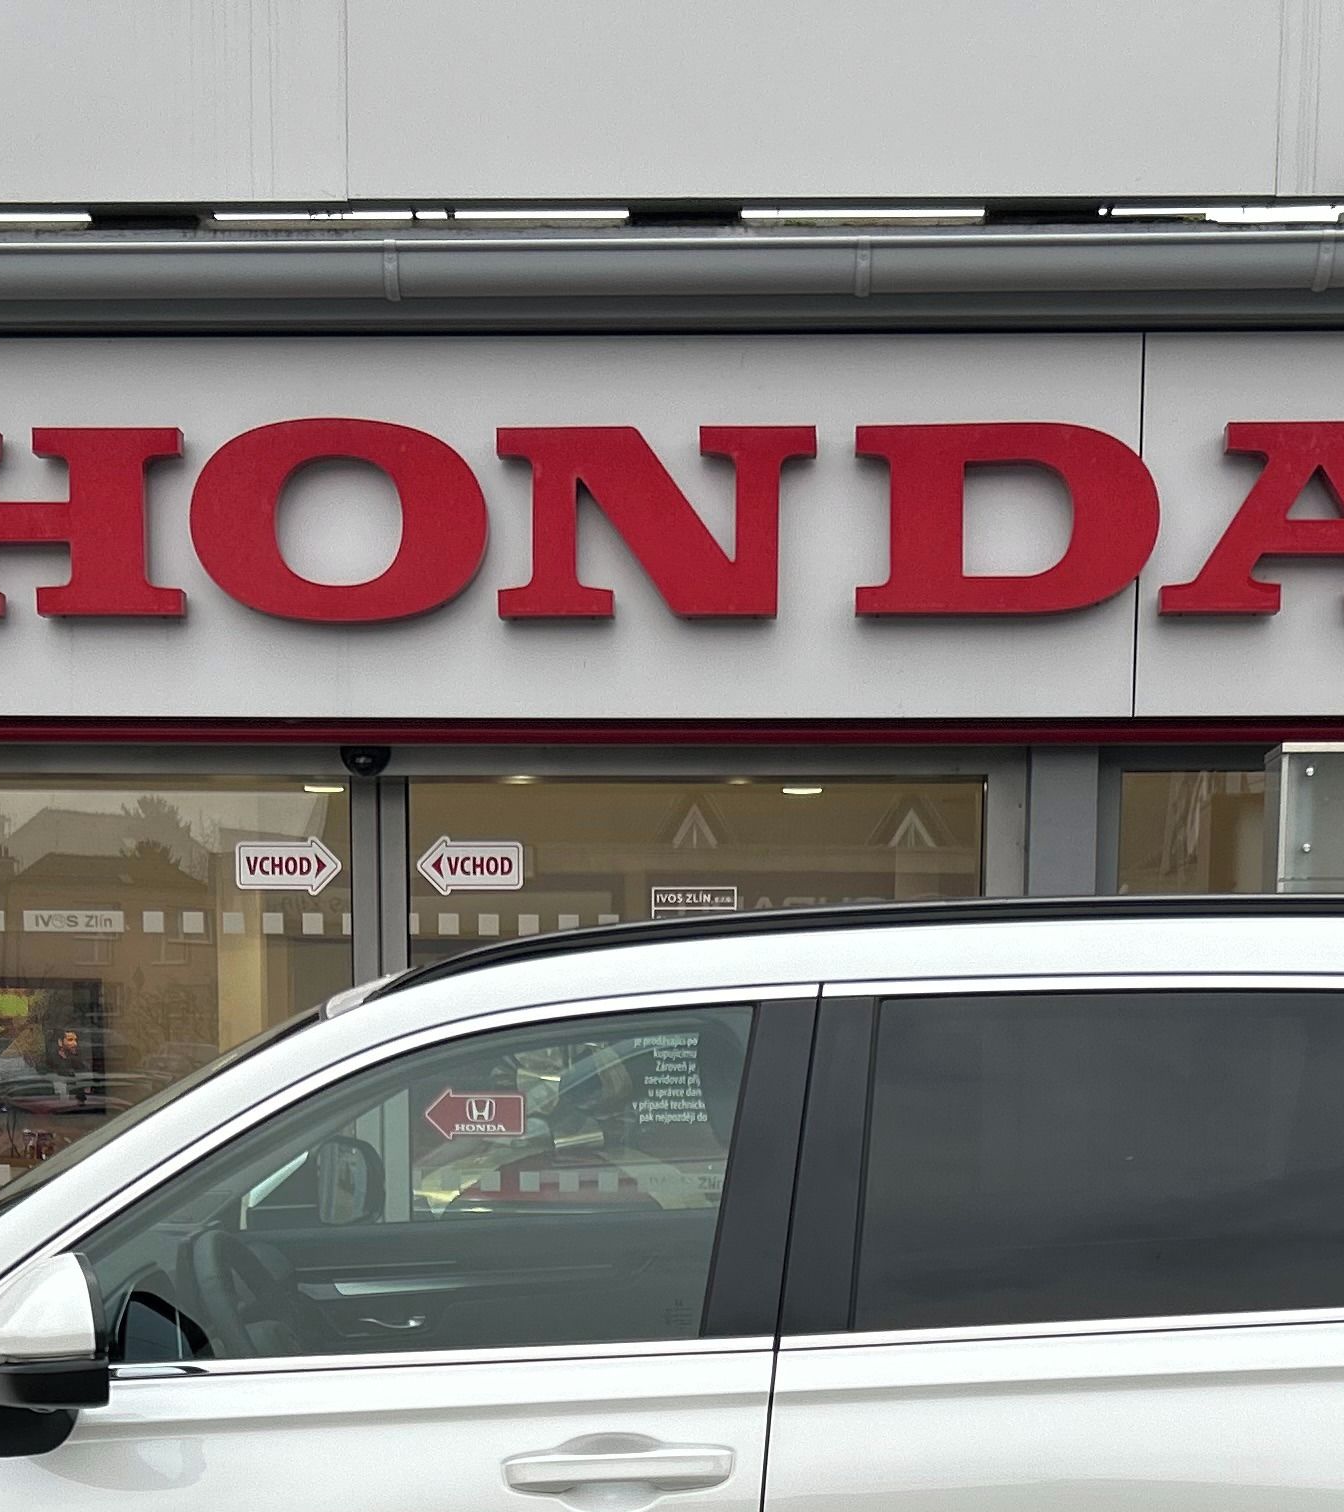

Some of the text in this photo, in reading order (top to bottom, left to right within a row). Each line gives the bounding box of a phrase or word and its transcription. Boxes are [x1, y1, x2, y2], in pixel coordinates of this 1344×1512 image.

[245, 856, 312, 876] VCHOD
[447, 856, 514, 876] VCHOD
[454, 1124, 506, 1132] HONDA
